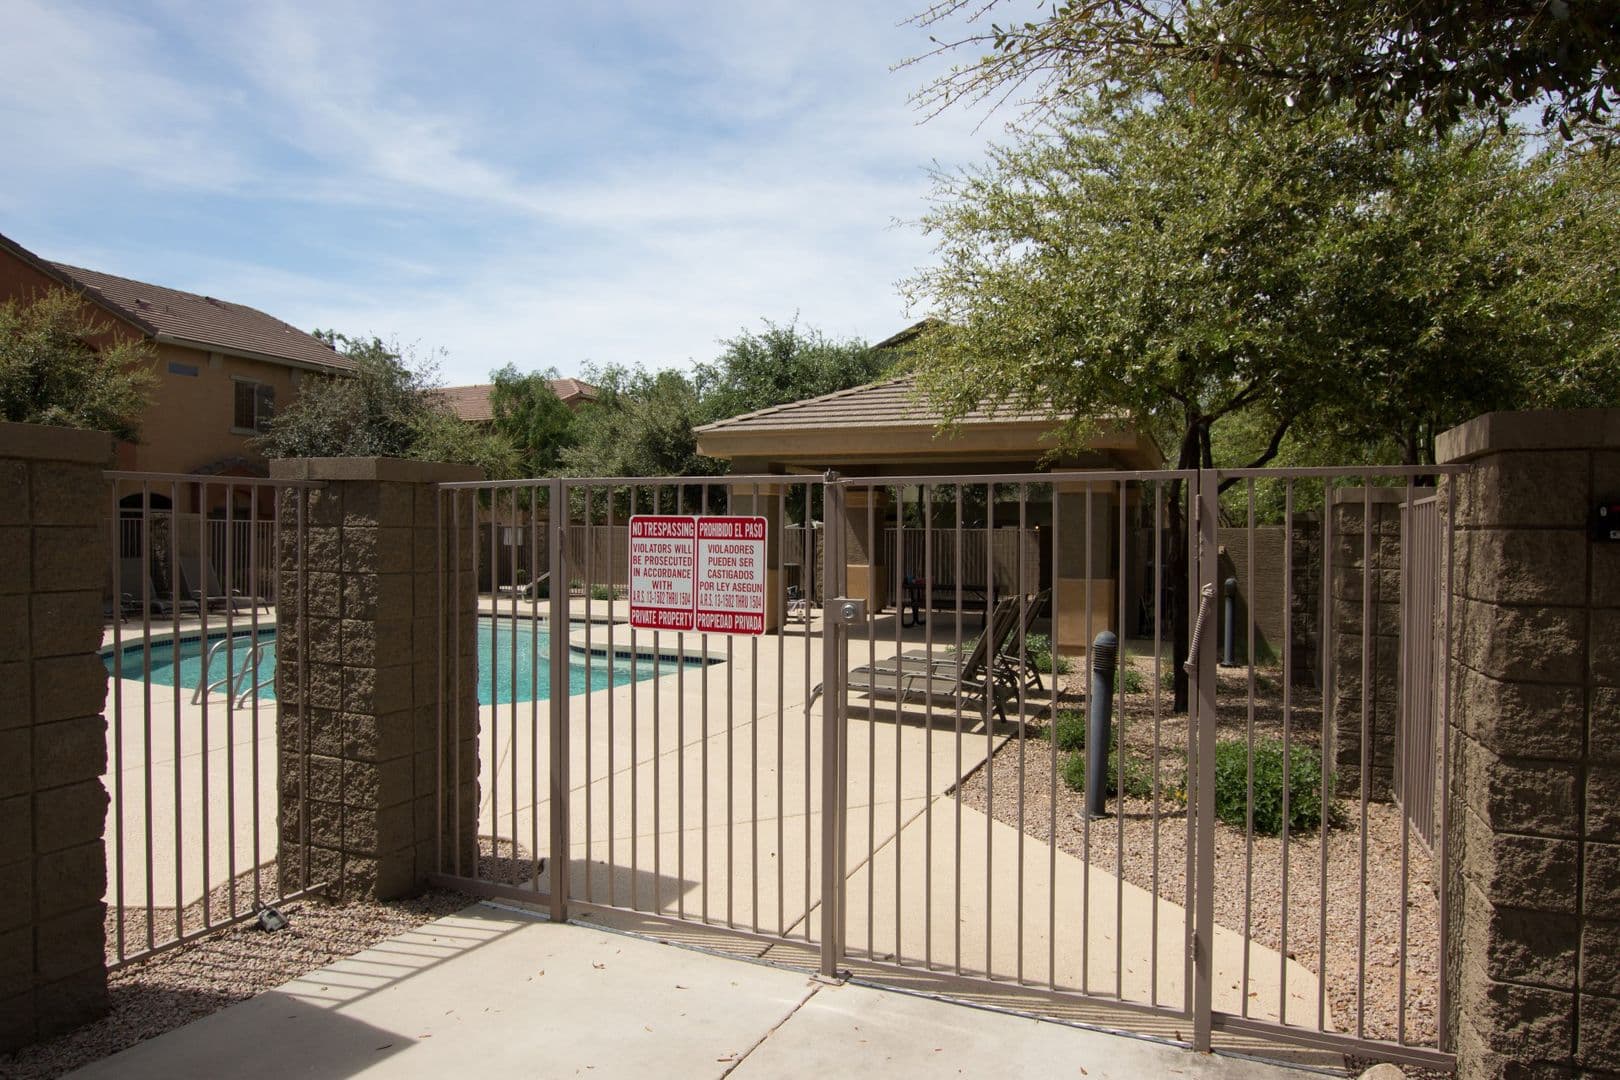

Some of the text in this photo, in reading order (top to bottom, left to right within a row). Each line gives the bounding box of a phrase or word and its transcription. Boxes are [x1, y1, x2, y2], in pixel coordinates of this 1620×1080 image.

[632, 522, 694, 536] NO TRESPASSING
[700, 524, 762, 538] PROHIBIDO EL PASO
[633, 544, 692, 554] VIOLATORS WILL
[708, 544, 754, 554] VIOLADORES
[633, 556, 692, 566] BE PROSECUTED
[708, 557, 754, 567] PUEDEN SER
[634, 568, 691, 578] IN ACCORDANCE
[708, 570, 754, 579] CASTIGADOS
[652, 580, 672, 590] WITH
[700, 582, 762, 592] POR LEY ASEGUN
[666, 592, 678, 605] THRU
[679, 592, 690, 605] 1504
[734, 595, 748, 608] THRU
[750, 595, 761, 608] 1504
[632, 611, 693, 626] PRIVATE PROPERTY
[698, 614, 762, 630] PROPIEDAD PRIVADA
